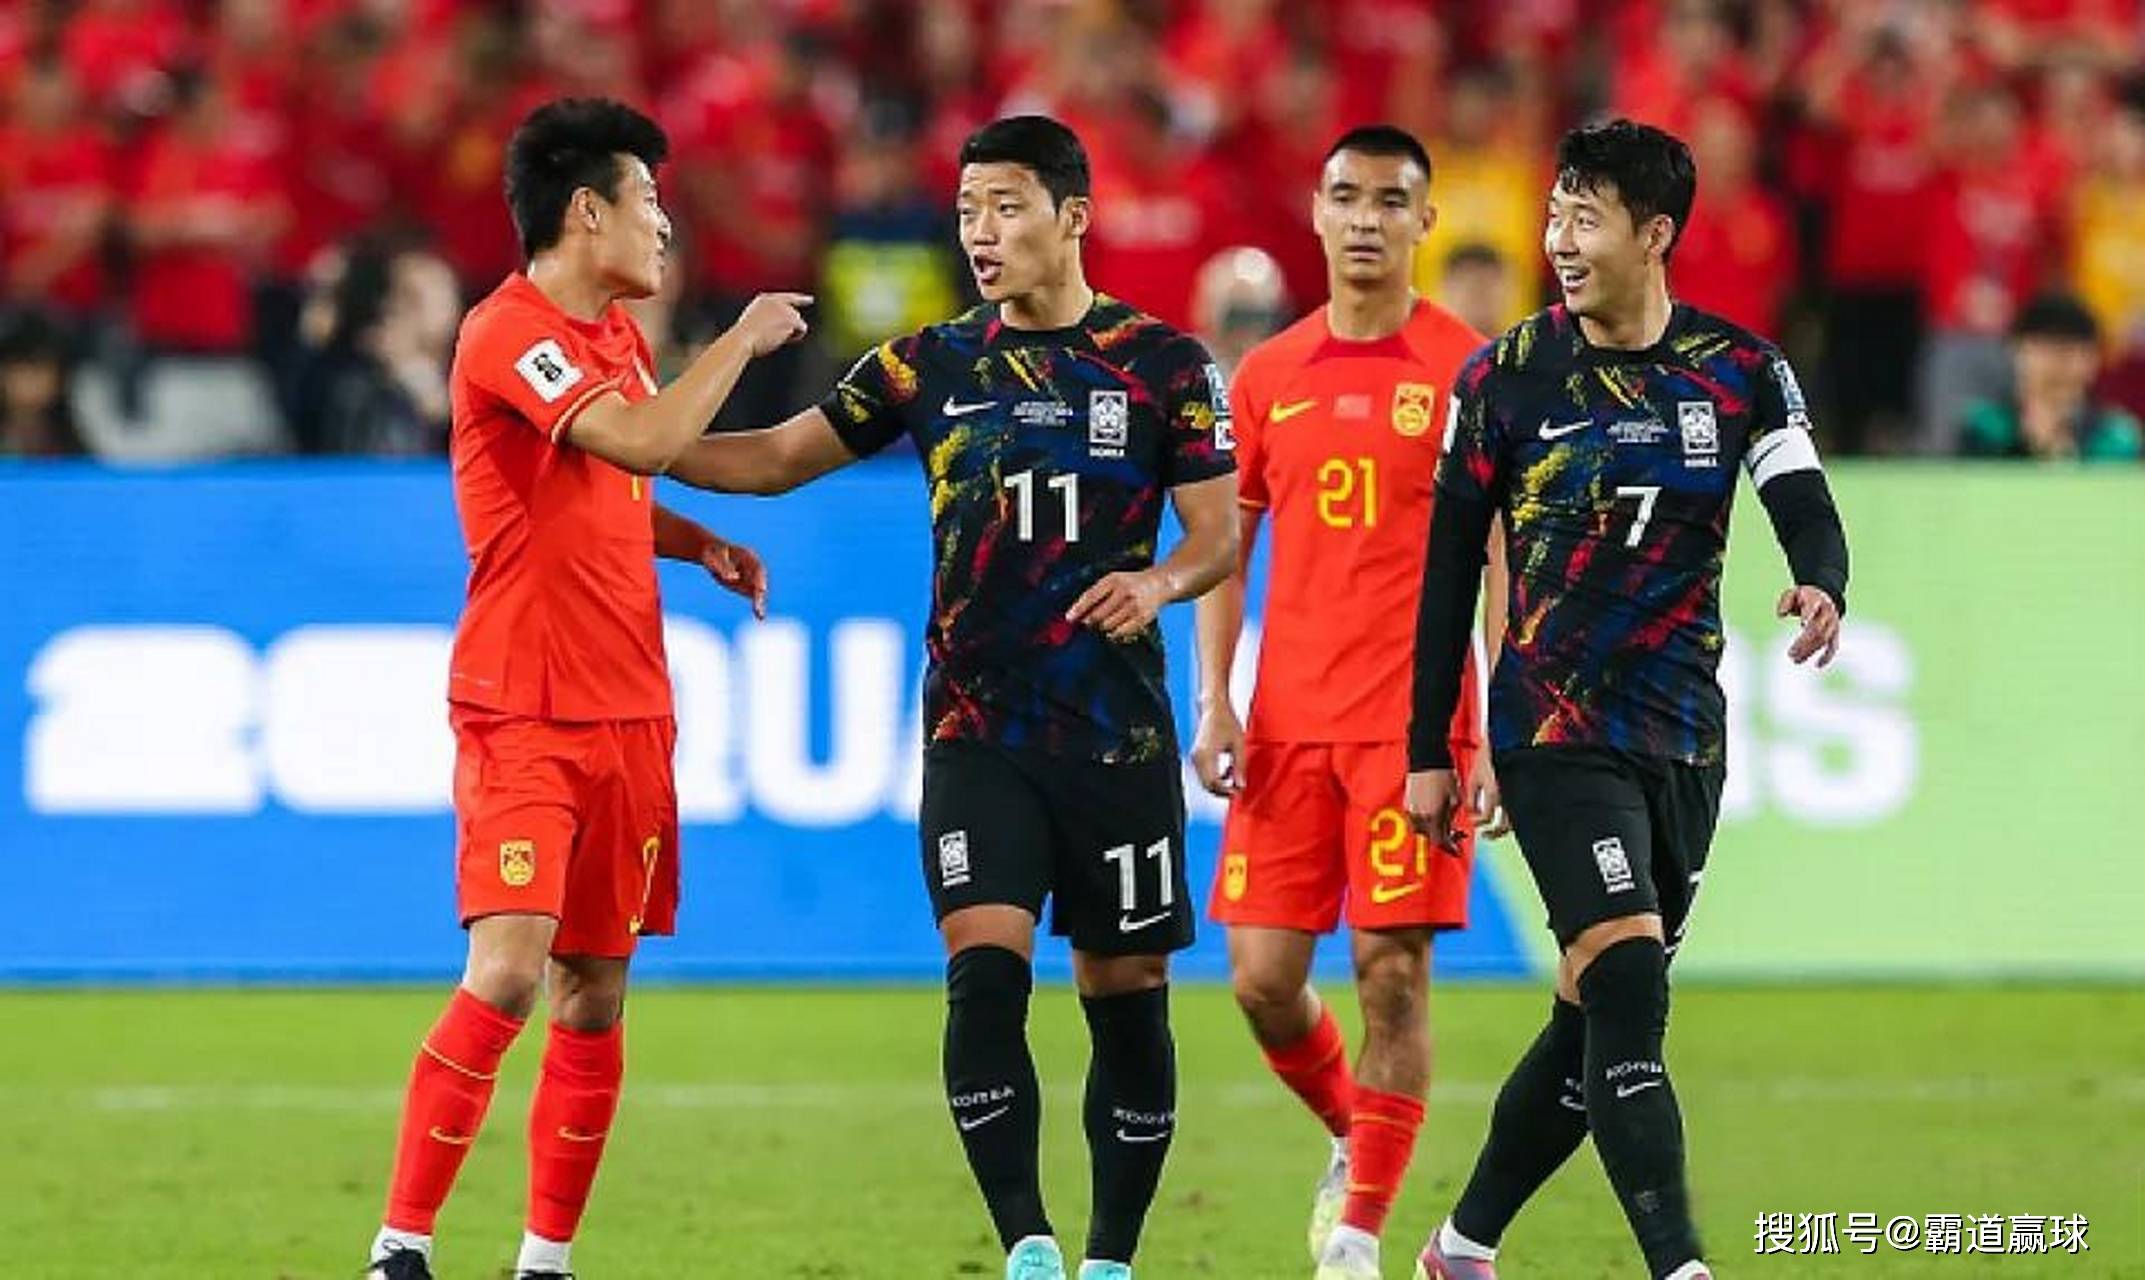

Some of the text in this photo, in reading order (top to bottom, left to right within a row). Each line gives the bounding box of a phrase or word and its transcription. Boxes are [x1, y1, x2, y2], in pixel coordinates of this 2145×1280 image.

[1003, 469, 1080, 542] 11
[1317, 456, 1376, 528] 21
[1616, 486, 1662, 546] 7
[1104, 836, 1172, 910] 11
[1370, 807, 1428, 877] 21
